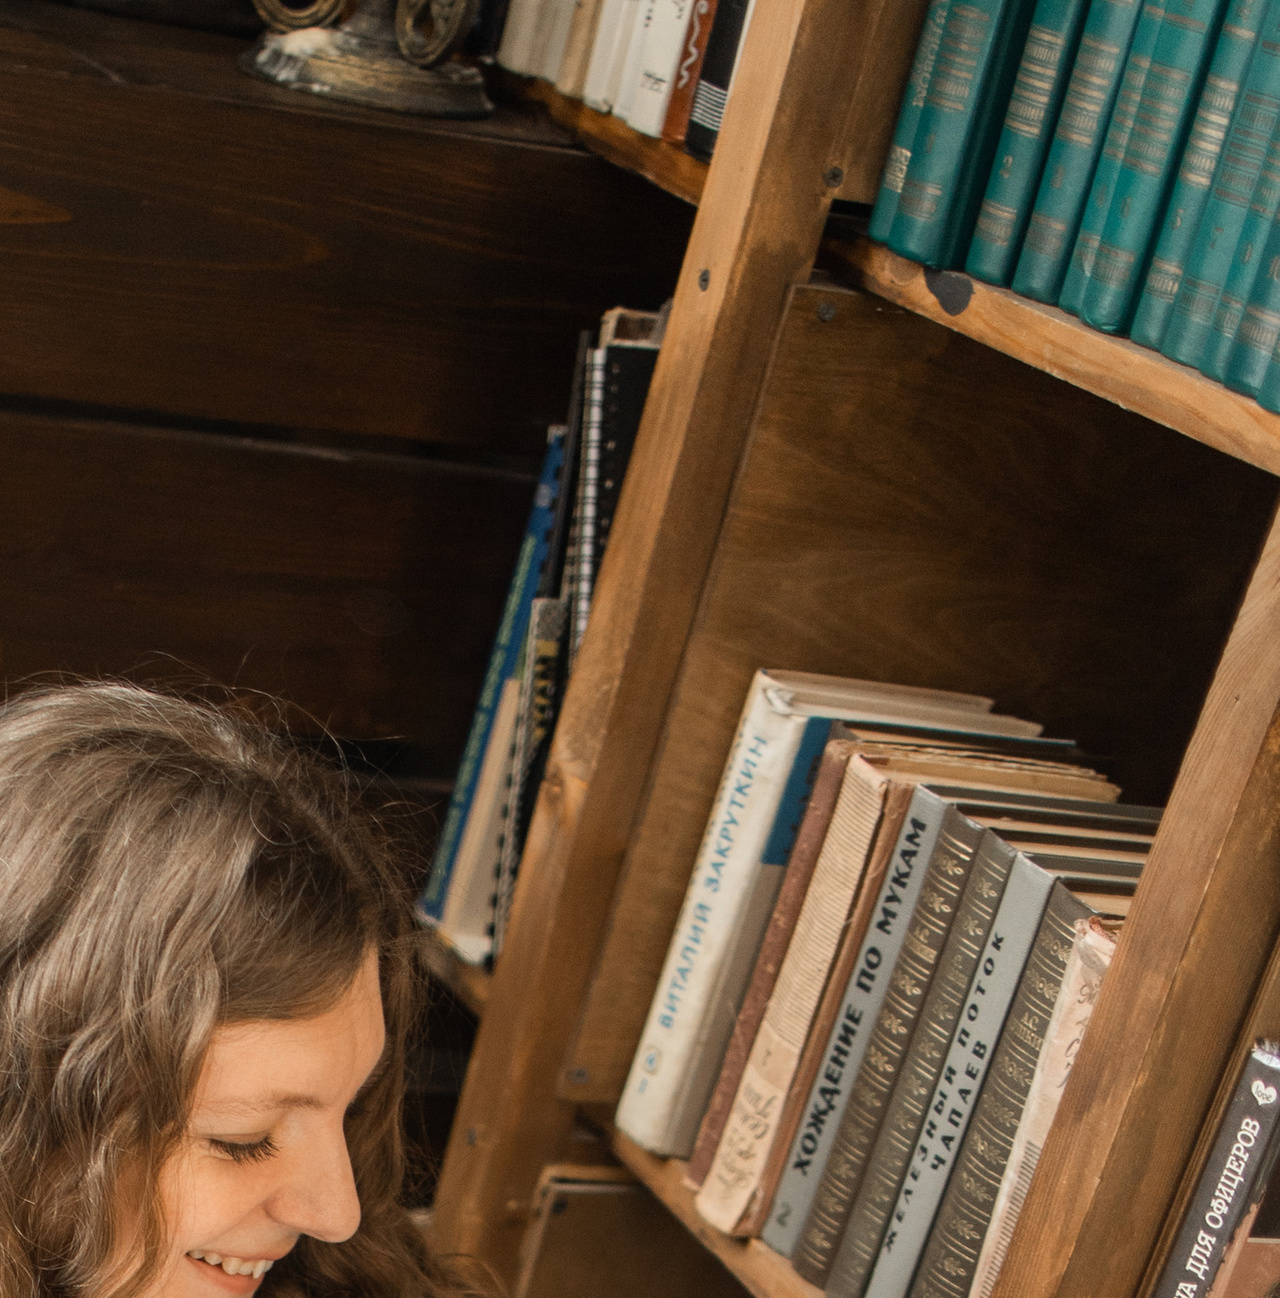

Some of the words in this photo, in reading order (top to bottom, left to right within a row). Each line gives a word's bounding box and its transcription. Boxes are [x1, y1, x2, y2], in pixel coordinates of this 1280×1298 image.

[999, 155, 1014, 179] 2
[658, 901, 712, 1030] ВИТАЛИЙ
[703, 735, 768, 893] ЗАКРУТКИН
[792, 1003, 864, 1178] ХОЖДЕНИЕ
[856, 946, 883, 994] ПО
[876, 816, 927, 936] МУКАМ
[957, 931, 1005, 1048] ПОТОК
[931, 1040, 988, 1173] ЧАПАЕВ
[775, 1200, 793, 1228] 2
[1185, 1229, 1217, 1281] ДЛЯ
[1205, 1117, 1261, 1230] ОФИЦЕРОВ
